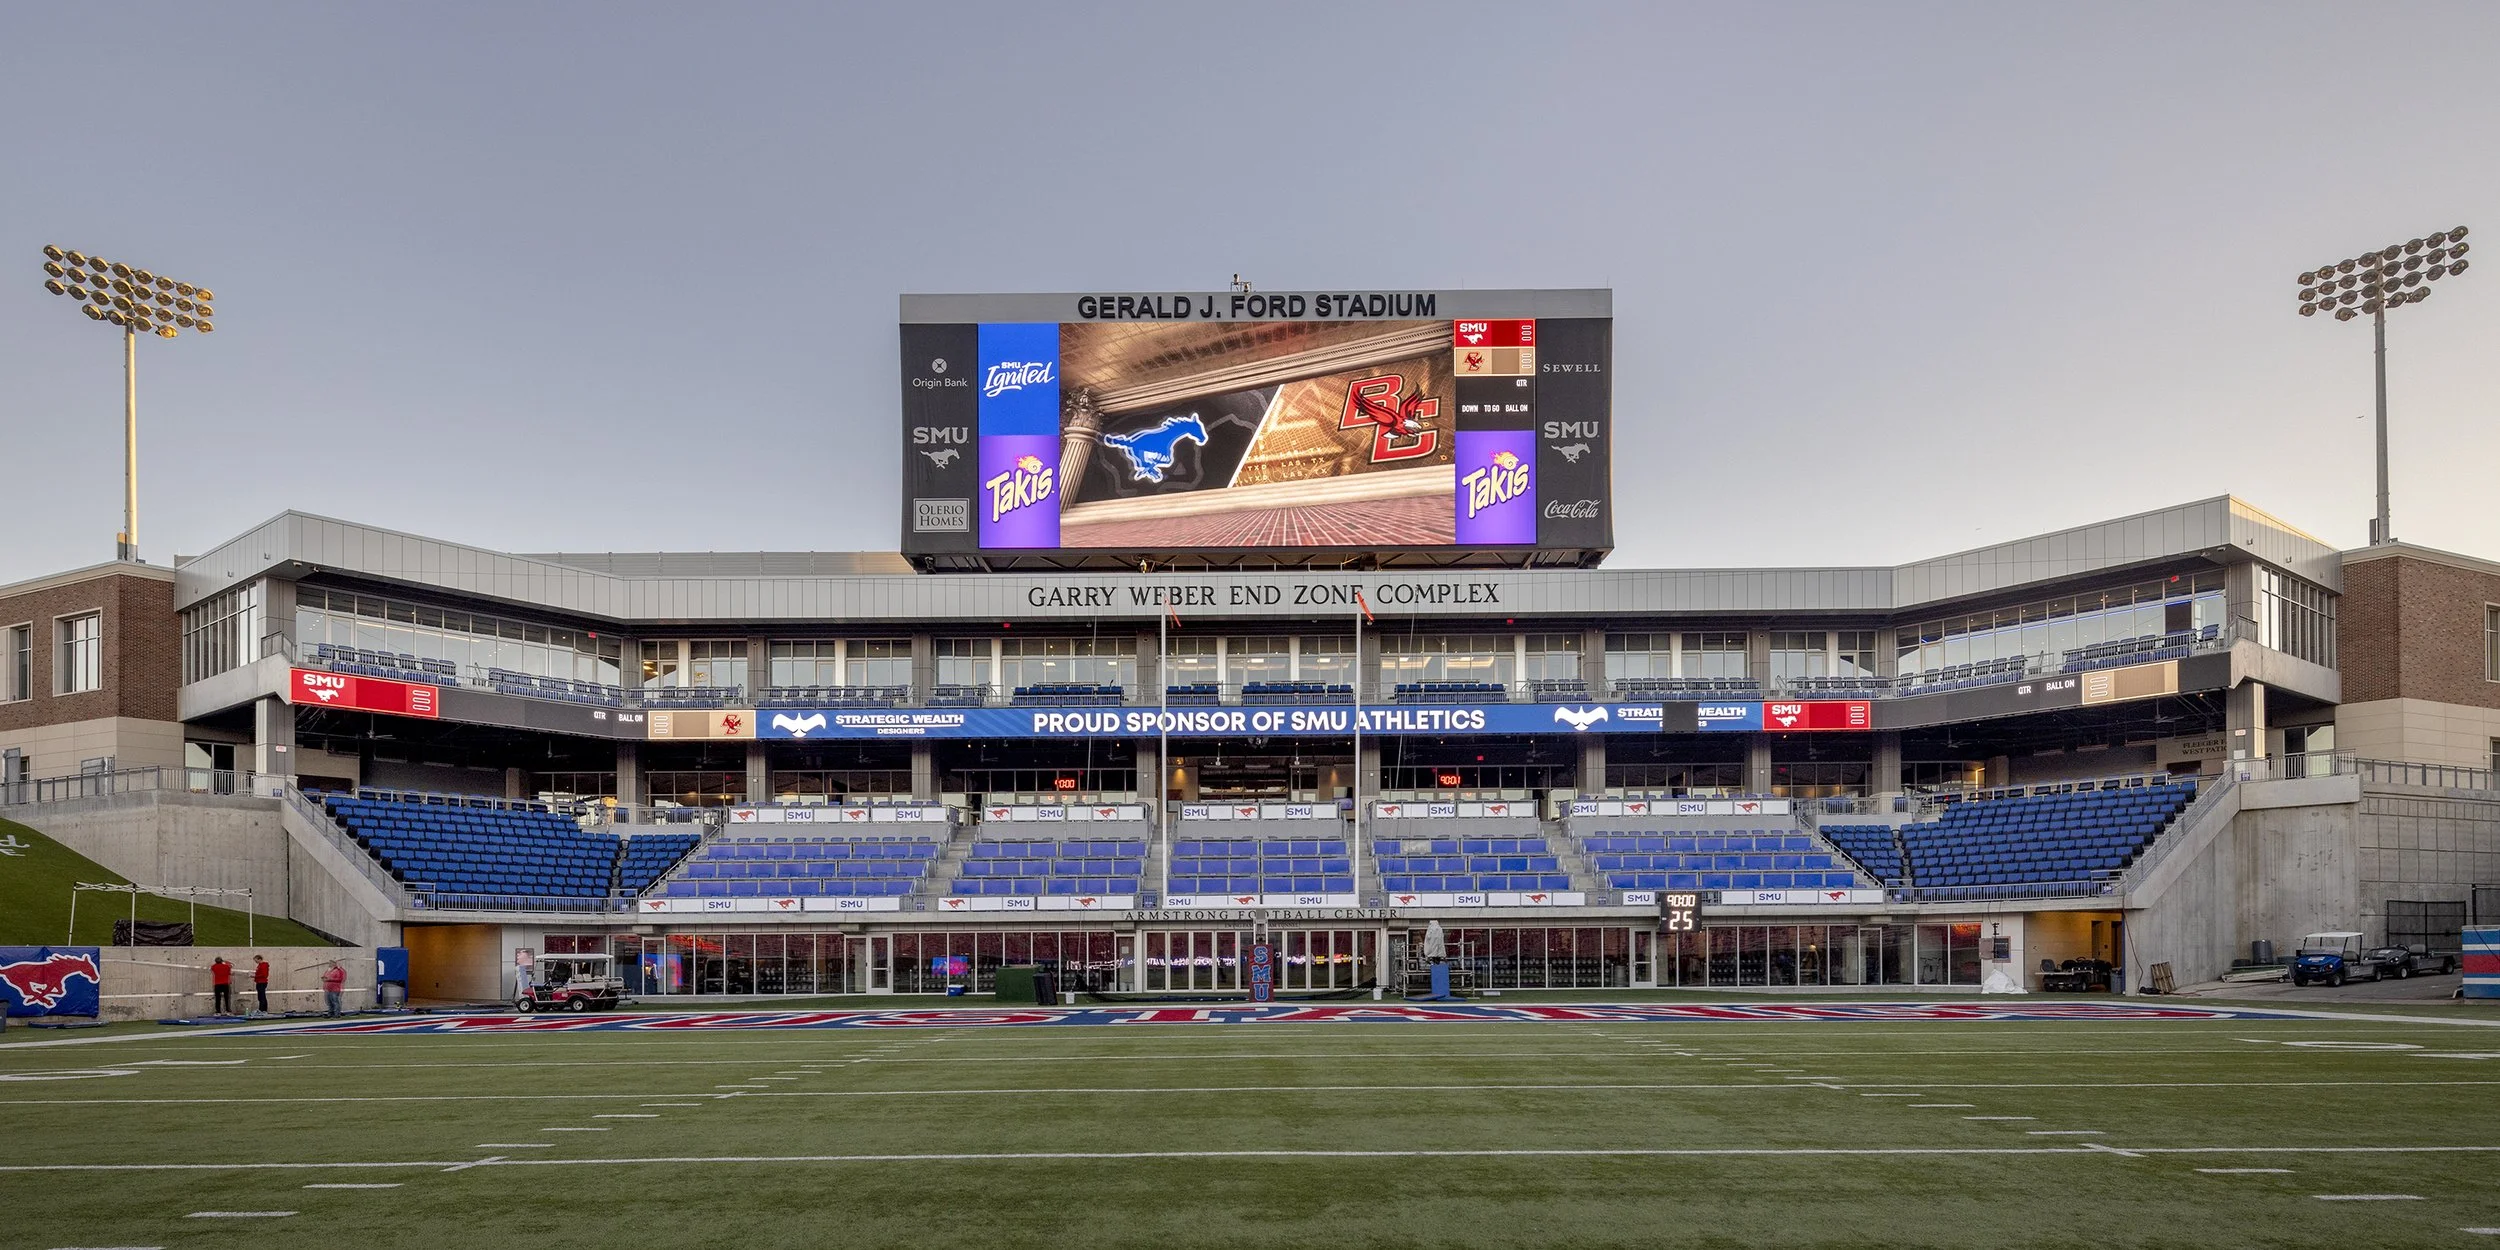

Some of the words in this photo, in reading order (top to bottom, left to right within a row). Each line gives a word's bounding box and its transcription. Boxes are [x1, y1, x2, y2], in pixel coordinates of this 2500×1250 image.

[1077, 295, 1191, 319] GERALD
[1200, 295, 1221, 318] J.
[1231, 294, 1306, 318] FORD
[1314, 293, 1437, 317] STADIUM
[1459, 322, 1488, 332] SMU
[1001, 361, 1021, 369] SMU
[1543, 363, 1601, 373] SEWELL
[912, 377, 942, 389] Origin
[944, 377, 968, 388] Bank
[982, 361, 1055, 397] Ignited
[1516, 379, 1528, 387] QTR
[1461, 404, 1479, 413] DOWN
[1484, 404, 1491, 412] TO
[1492, 404, 1500, 412] GO
[1505, 404, 1519, 412] BALL
[1520, 403, 1528, 412] ON
[913, 426, 969, 444] SMU
[1544, 421, 1600, 439] SMU
[985, 467, 1055, 522] Takis
[1461, 463, 1531, 519] Takis
[919, 503, 965, 516] OLERIO
[919, 515, 964, 527] HOMES
[1028, 586, 1117, 607] GARRY
[1128, 585, 1217, 606] WEBER
[1230, 584, 1282, 606] END
[1293, 583, 1364, 605] ZONE
[1376, 583, 1500, 604] COMPLEX
[303, 673, 346, 689] SMU
[2018, 685, 2032, 695] QTR
[2046, 680, 2064, 691] BALL
[2064, 679, 2075, 688] ON
[1617, 707, 1662, 717] STRAT
[1771, 705, 1802, 715] SMU
[593, 711, 606, 720] QTR
[618, 713, 634, 722] BALL
[634, 714, 643, 722] ON
[835, 714, 910, 724] STRATEGIC
[912, 714, 965, 724] WEALTH
[1034, 712, 1121, 733] PROUD
[1126, 711, 1246, 733] SPONSOR
[1252, 711, 1285, 732] OF
[1291, 710, 1347, 732] SMU
[1352, 709, 1486, 731] ATHLETICS
[1184, 808, 1208, 816] SMU
[1286, 808, 1311, 816] SMU
[1430, 806, 1454, 815] SMU
[1573, 804, 1597, 813] SMU
[1680, 804, 1704, 812] SMU
[787, 811, 811, 820] SMU
[897, 810, 921, 819] SMU
[1040, 809, 1064, 818] SMU
[1168, 898, 1191, 906] SMU
[1300, 897, 1323, 905] SMU
[1458, 896, 1481, 904] SMU
[1627, 894, 1650, 902] SMU
[1667, 894, 1696, 907] 90:00
[1758, 893, 1782, 901] SMU
[708, 900, 731, 909] SMU
[840, 900, 863, 908] SMU
[1007, 899, 1030, 907] SMU
[1125, 910, 1229, 921] ARMSTRONG
[1334, 909, 1398, 920] CENTER
[1669, 910, 1693, 930] 25
[1251, 945, 1271, 1002] SMU
